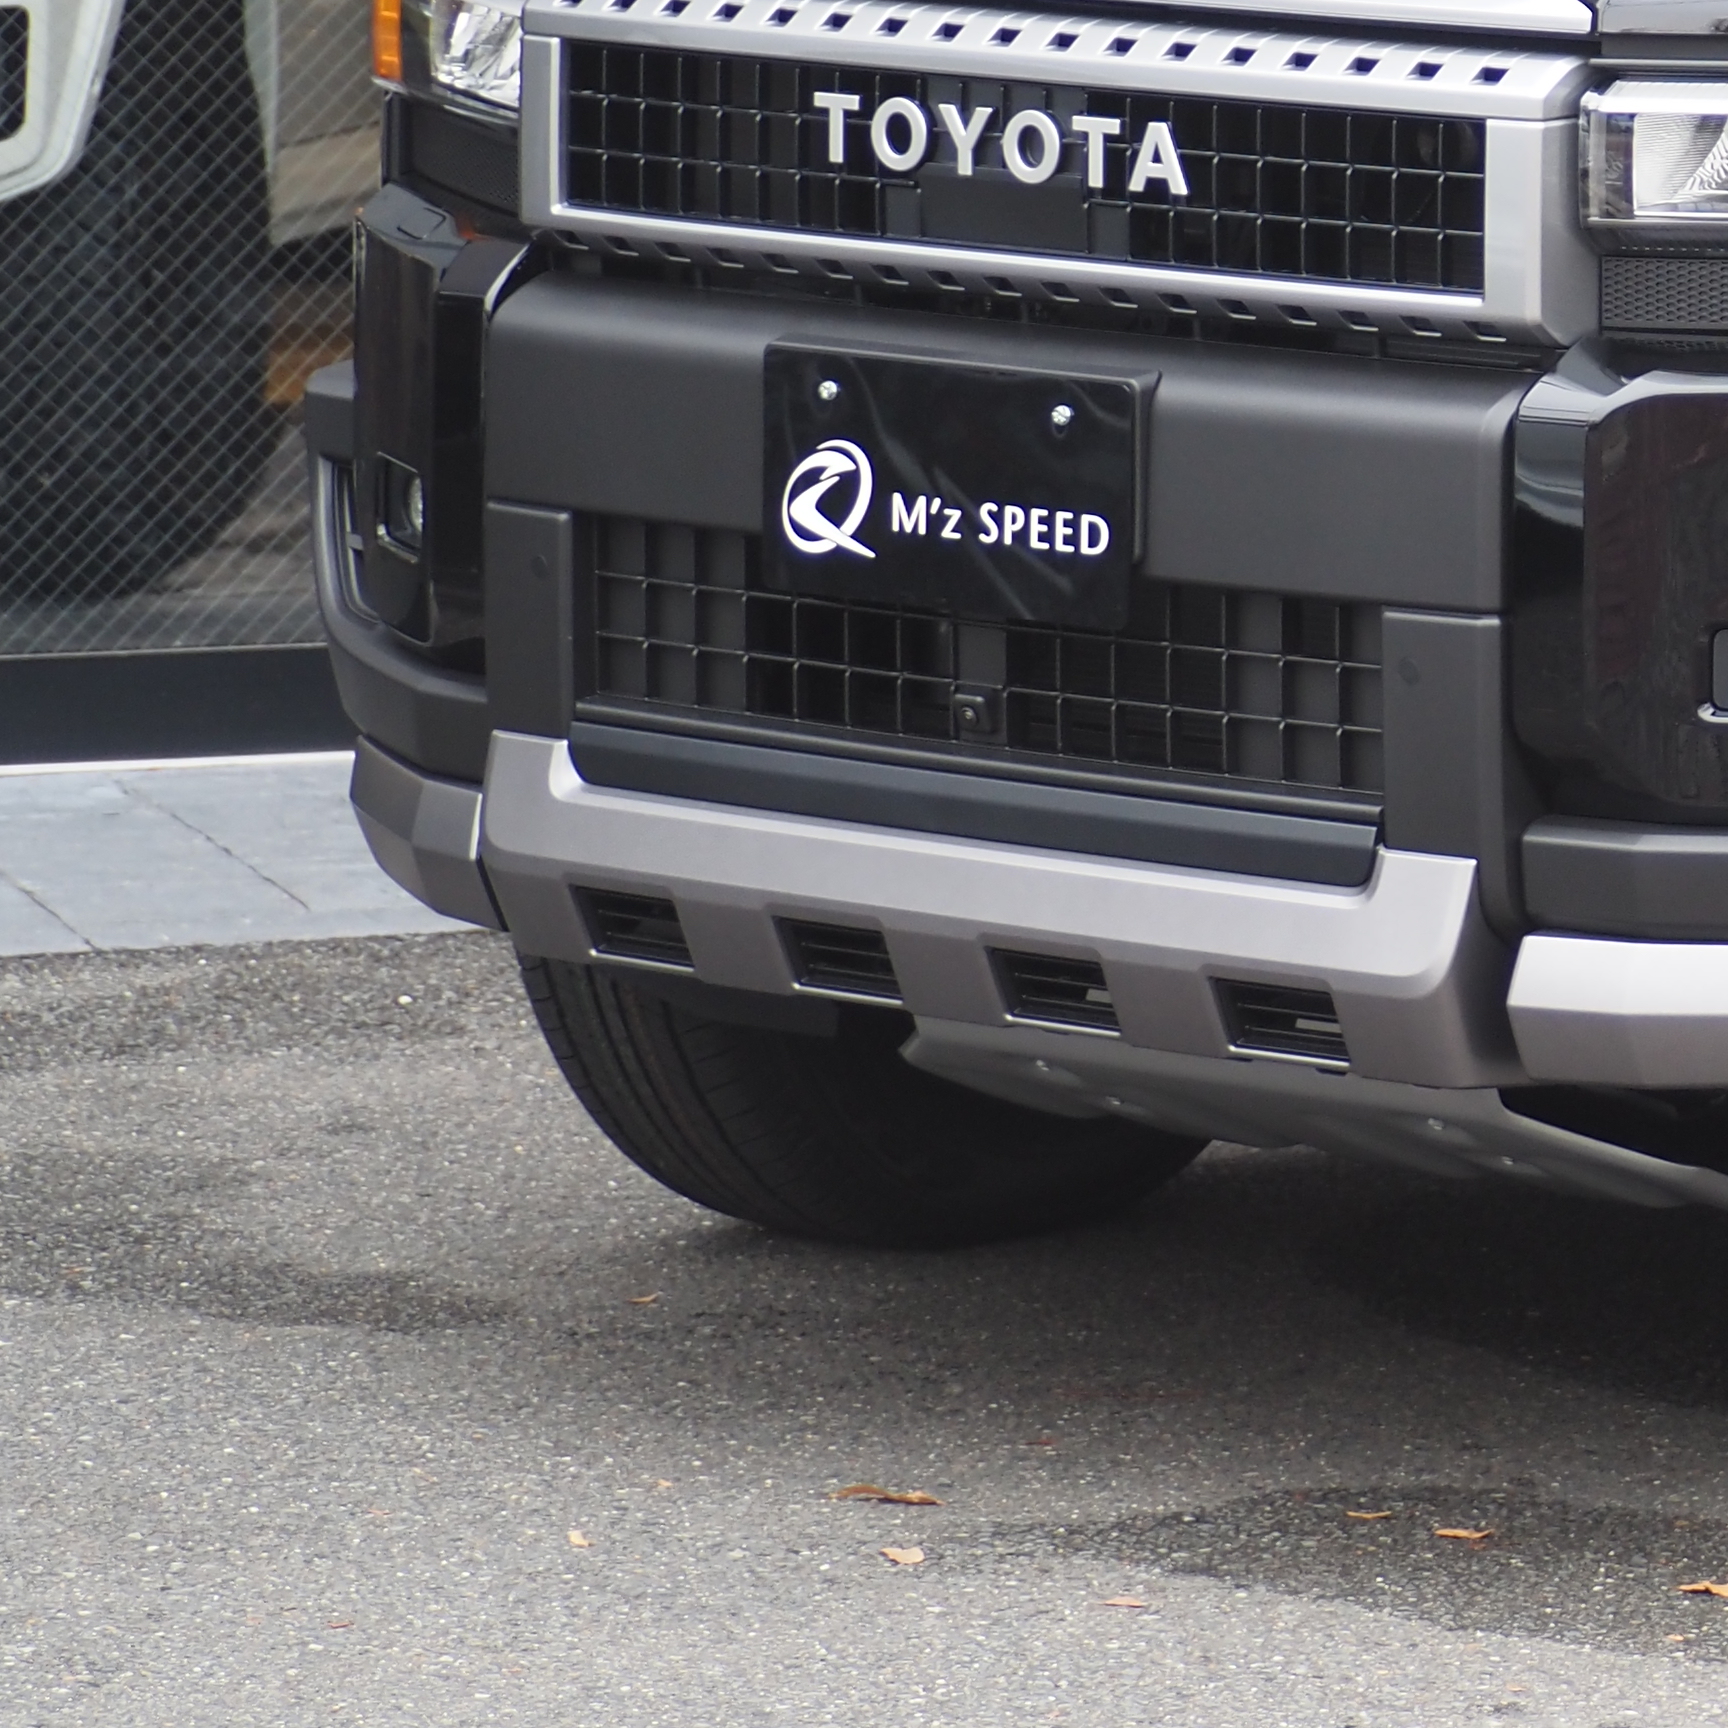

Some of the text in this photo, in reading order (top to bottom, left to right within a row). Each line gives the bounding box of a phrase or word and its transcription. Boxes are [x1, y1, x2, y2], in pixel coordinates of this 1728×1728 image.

[813, 91, 1189, 196] TOYOTA
[892, 491, 1110, 556] M'z SPEED
